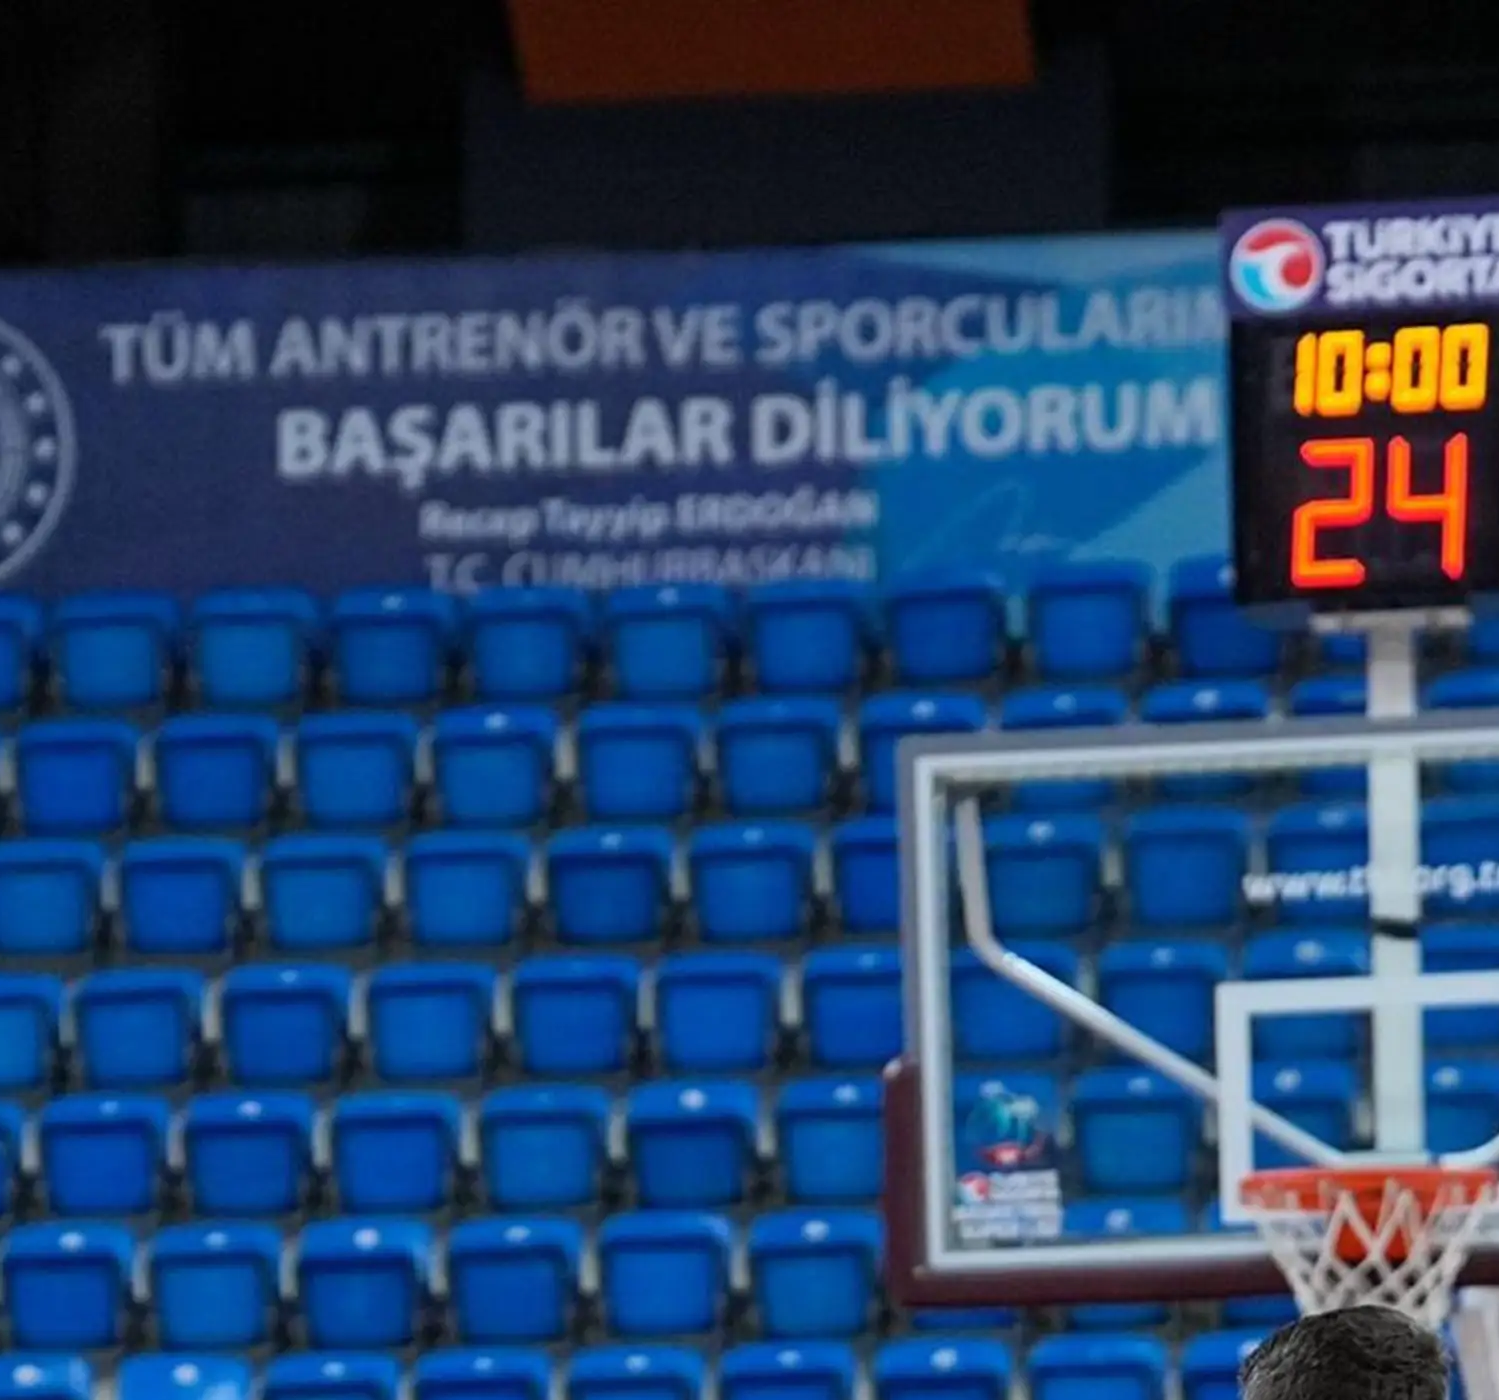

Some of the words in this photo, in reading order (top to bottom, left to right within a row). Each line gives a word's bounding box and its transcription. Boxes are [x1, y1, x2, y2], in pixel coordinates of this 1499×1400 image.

[102, 310, 256, 384] TÜM
[268, 298, 646, 378] ANTRENÖR
[653, 303, 741, 366] VE
[1294, 322, 1489, 417] 10:00
[275, 394, 735, 492] BAŞARILAR
[750, 373, 1220, 467] DİLİYORUM
[1291, 432, 1469, 588] 24
